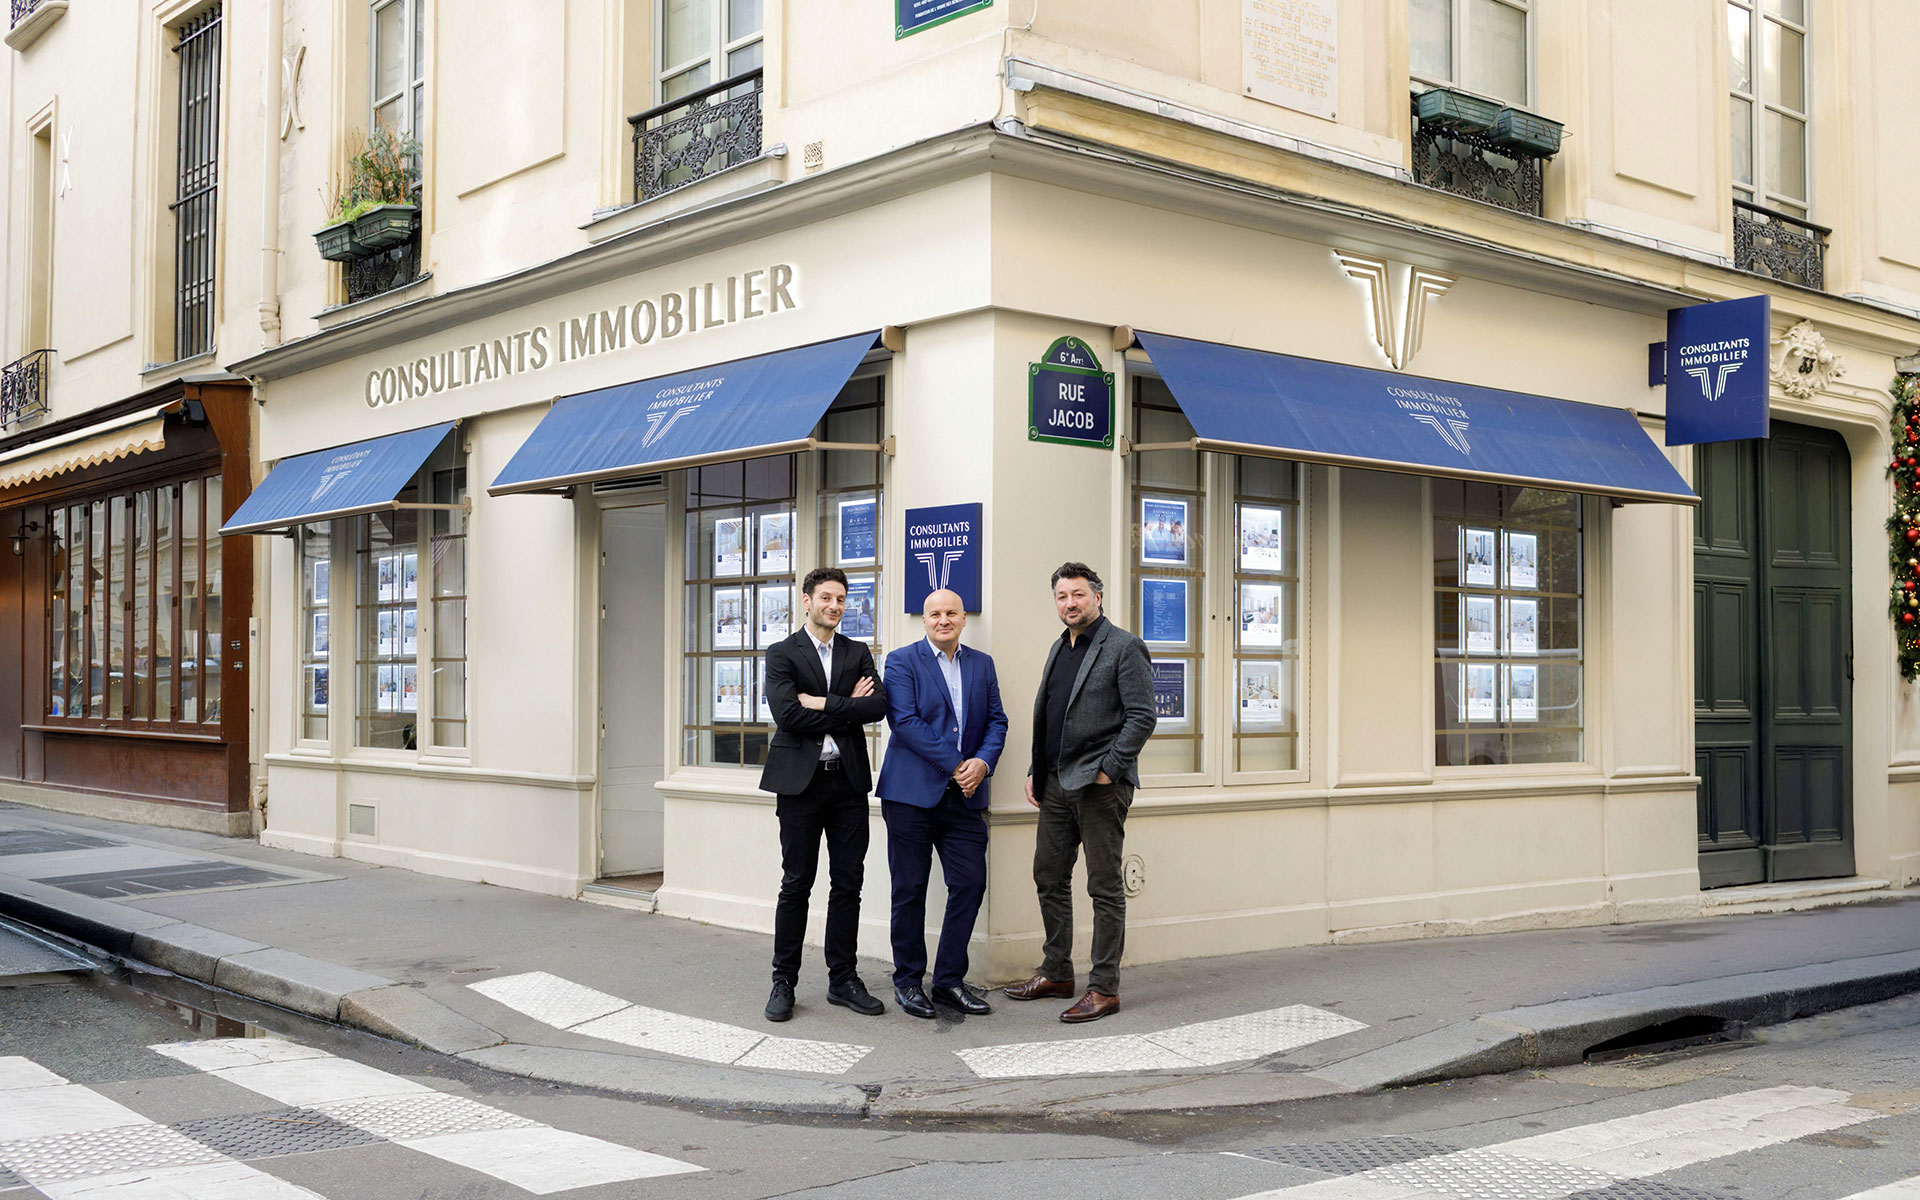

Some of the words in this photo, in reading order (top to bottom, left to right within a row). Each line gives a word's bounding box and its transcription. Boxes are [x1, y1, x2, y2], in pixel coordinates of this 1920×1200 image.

[365, 326, 548, 408] CONSULTANTS
[558, 263, 796, 362] IMMOBILIER
[1680, 338, 1750, 356] CONSULTANTS
[1680, 349, 1748, 367] IMMOBILIER
[655, 377, 725, 399] CONSULTANTS
[1059, 382, 1086, 402] RUE
[1386, 386, 1463, 408] CONSULTANTS
[646, 390, 714, 411] IMMOBILIER
[1395, 399, 1470, 420] IMMOBILIER
[1048, 408, 1094, 430] JACOB
[910, 521, 970, 536] CONSULTANTS
[910, 535, 969, 550] IMMOBILIER
